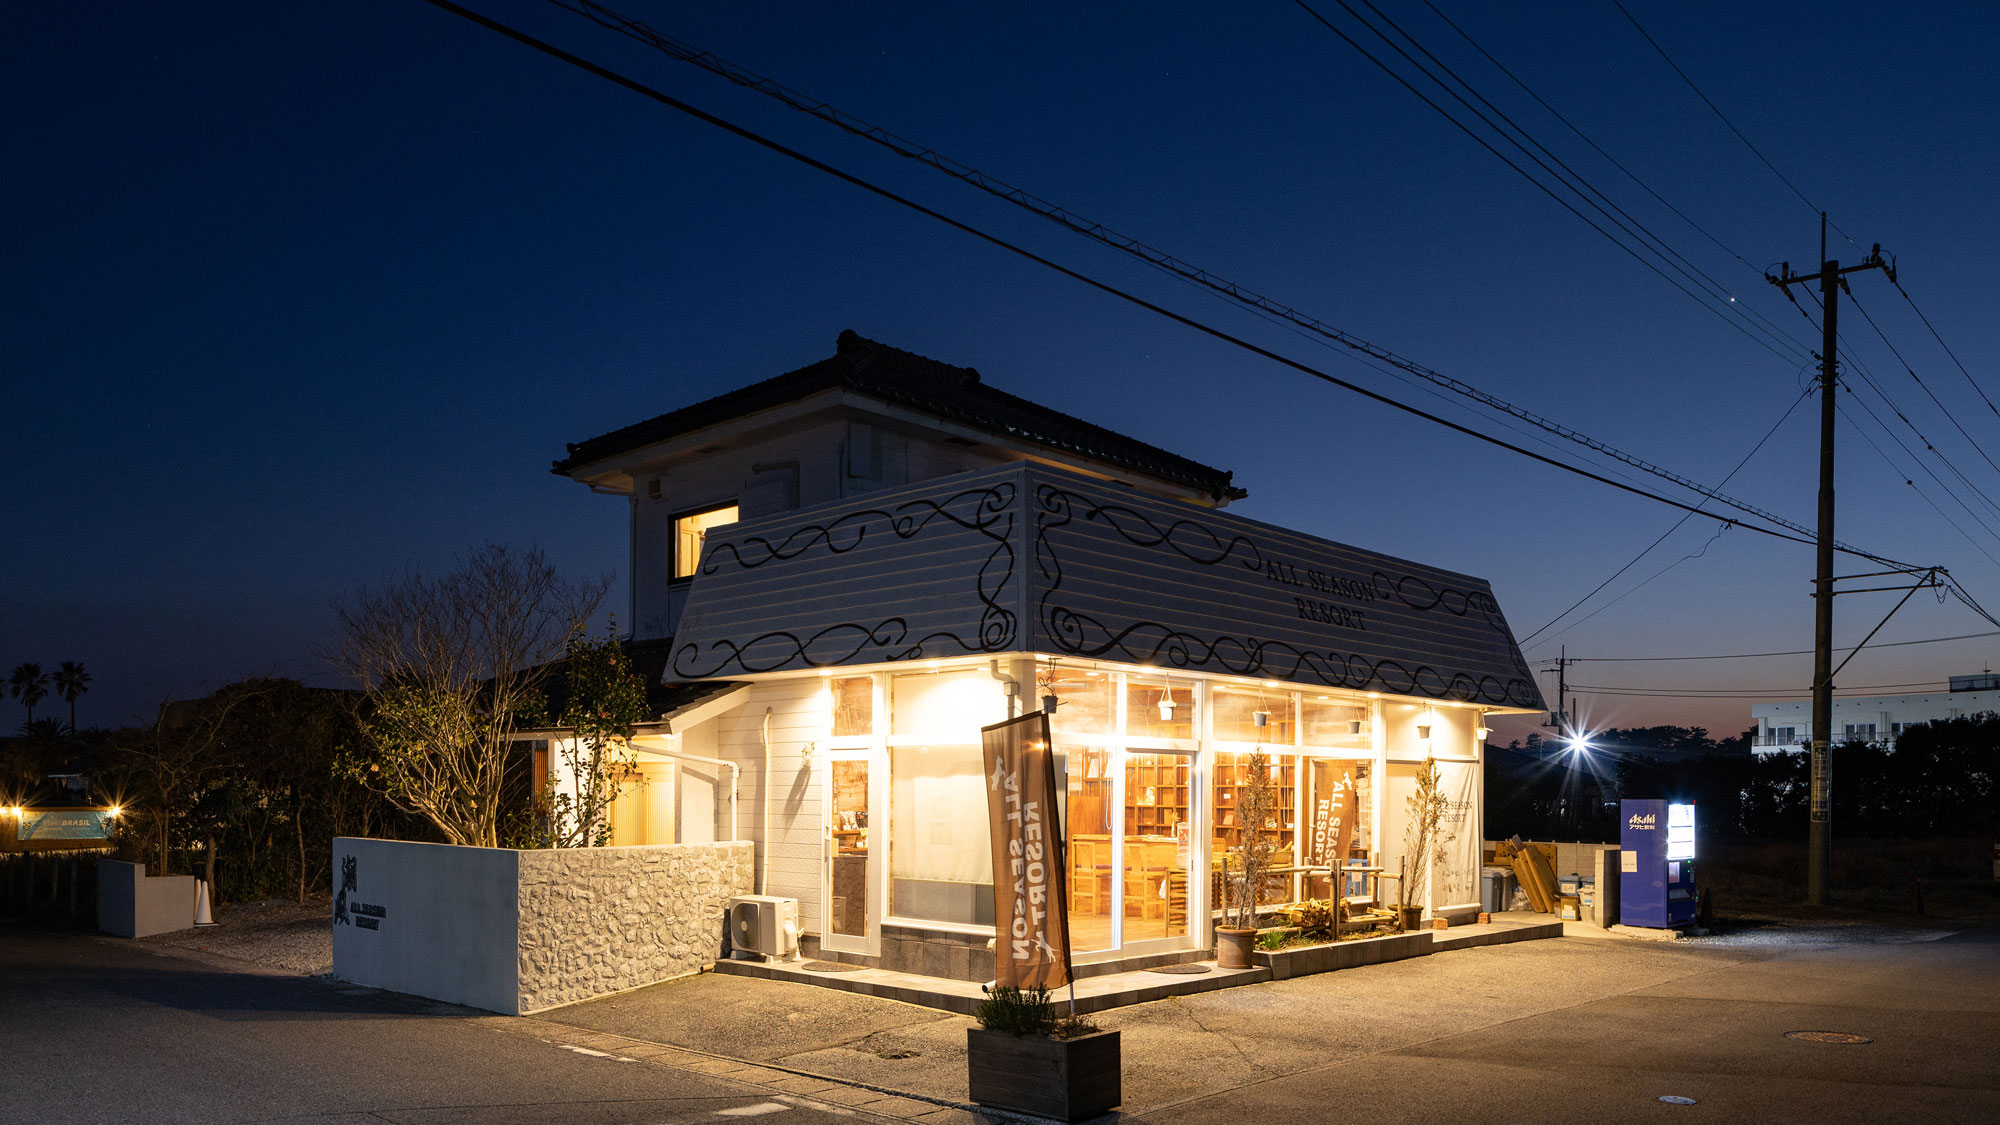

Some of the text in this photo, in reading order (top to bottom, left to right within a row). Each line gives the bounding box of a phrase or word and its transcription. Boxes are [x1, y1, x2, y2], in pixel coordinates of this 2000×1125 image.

[1266, 559, 1375, 602] ALL SEASON
[1294, 597, 1367, 630] RESORT
[1331, 780, 1345, 812] ALL
[1315, 799, 1330, 865] RESORT
[1629, 813, 1656, 824] Asahi
